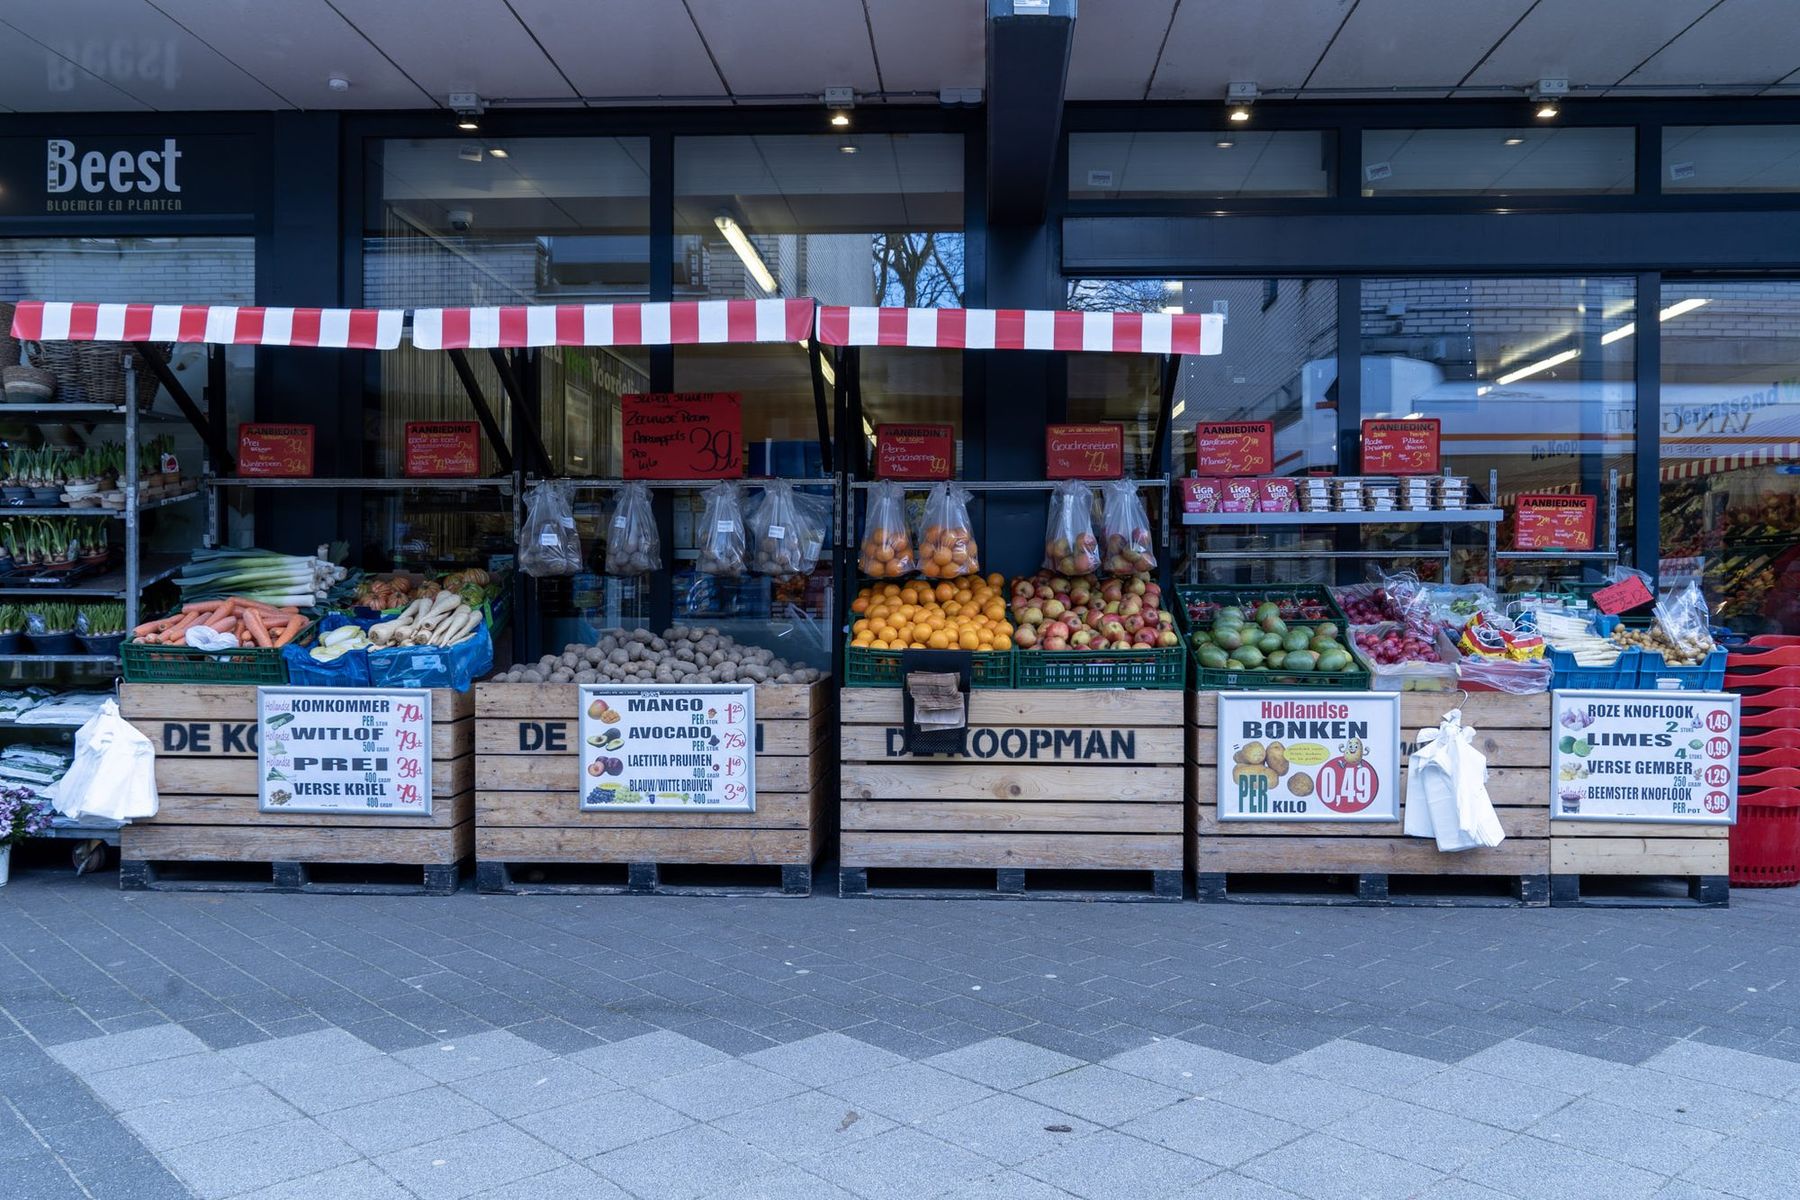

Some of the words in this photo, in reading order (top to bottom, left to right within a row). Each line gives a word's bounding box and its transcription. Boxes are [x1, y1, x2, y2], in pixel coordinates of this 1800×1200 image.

[48, 139, 182, 193] Beest
[128, 199, 182, 211] PLANTEN
[411, 425, 472, 434] AANBIEDING
[1203, 425, 1265, 434] AANBIEDING
[1371, 423, 1435, 432] AANBIEDING
[1523, 499, 1587, 508] AANBIEDING
[291, 699, 390, 713] KOMKOMMER
[628, 698, 704, 712] MANGO
[1261, 701, 1349, 720] Hollandse
[1587, 704, 1620, 718] ROZE
[1624, 704, 1694, 719] KNOFLOOK
[362, 716, 374, 726] PER
[691, 713, 705, 725] PER
[1707, 713, 1729, 729] 1,49
[628, 726, 712, 739] AVOCADO
[1242, 720, 1368, 739] BONKEN
[1665, 721, 1678, 733] 2
[164, 723, 211, 752] DE
[291, 727, 384, 741] WITLOF
[519, 722, 567, 751] DE
[1587, 733, 1673, 747] LIMES
[363, 741, 375, 752] 500
[692, 740, 705, 751] PER
[1707, 741, 1728, 757] 0,99
[1674, 748, 1687, 759] 4
[293, 757, 388, 771] PREI
[627, 754, 668, 767] LAETITIA
[669, 754, 712, 767] PRUIMEN
[693, 767, 706, 778] 400
[1587, 760, 1632, 774] VERSE
[1635, 761, 1693, 775] GEMBER
[365, 772, 377, 783] 400
[1673, 776, 1687, 787] 250
[1706, 769, 1728, 784] 1,29
[294, 782, 343, 796] VERSE
[345, 783, 387, 796] KRIEL
[629, 779, 681, 792] BLAUW/WITTE
[681, 779, 713, 792] DRUIVEN
[1321, 766, 1371, 806] 0,49
[693, 793, 706, 804] 400
[1238, 774, 1268, 813] PER
[1272, 800, 1307, 813] KILO
[1588, 786, 1639, 800] BEEMSTER
[1641, 787, 1692, 801] KNOFLOOK
[366, 797, 379, 808] 400
[1672, 802, 1686, 814] PER
[1705, 796, 1728, 811] 3,99
